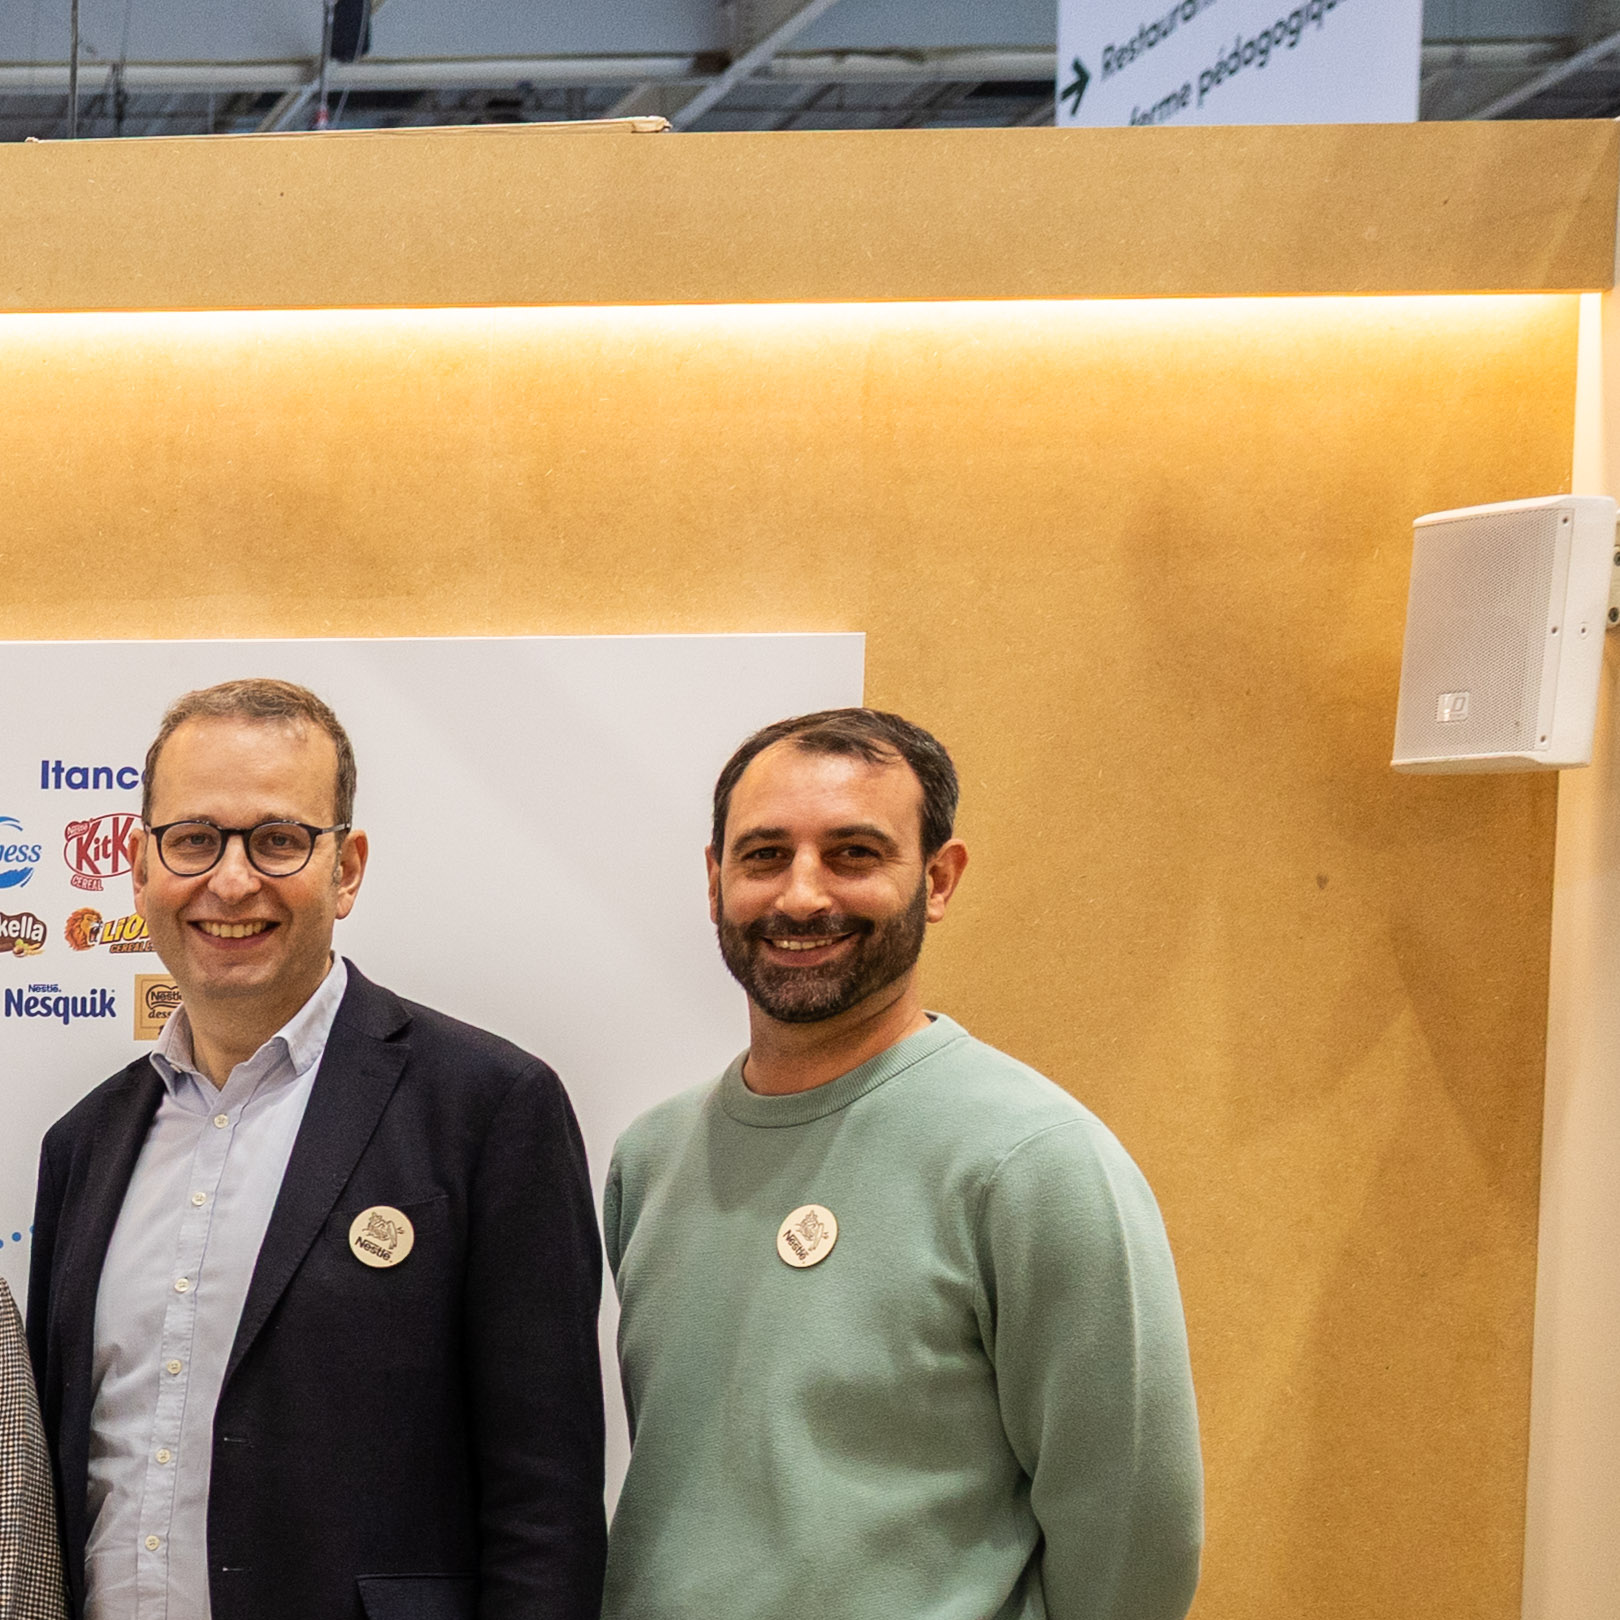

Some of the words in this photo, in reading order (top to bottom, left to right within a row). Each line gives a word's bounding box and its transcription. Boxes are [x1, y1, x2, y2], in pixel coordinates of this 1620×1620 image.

[1101, 0, 1217, 80] Restaura
[1197, 0, 1346, 108] pédagogiq
[41, 760, 147, 789] Itanc
[5, 988, 116, 1025] Nesquik
